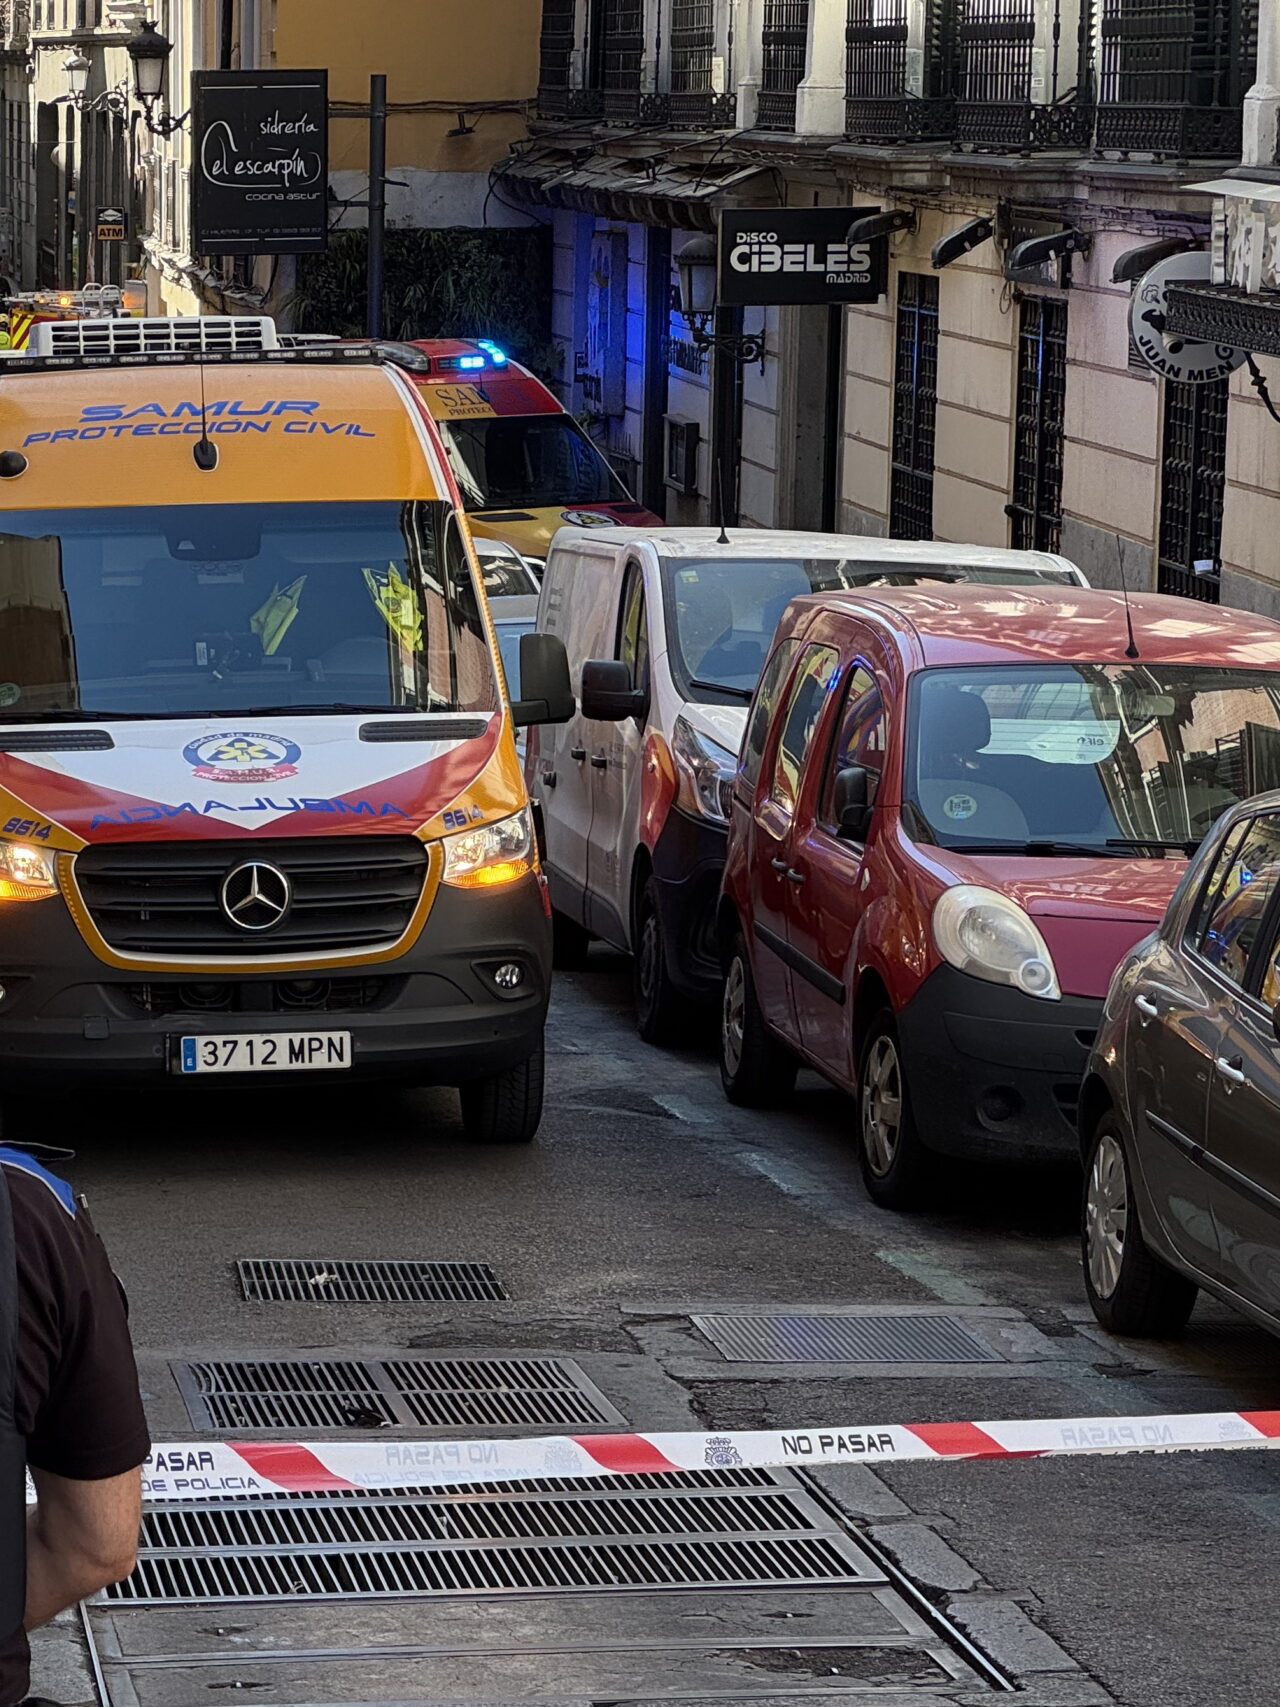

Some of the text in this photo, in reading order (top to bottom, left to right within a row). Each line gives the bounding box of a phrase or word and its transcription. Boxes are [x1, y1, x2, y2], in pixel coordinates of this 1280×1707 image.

[260, 110, 319, 134] sidrería
[234, 148, 309, 187] escarpín
[245, 193, 284, 201] cocina
[99, 228, 123, 237] ATM
[1138, 335, 1182, 379] JUAN
[79, 400, 320, 423] SAMUR
[22, 418, 376, 448] PROTECCIÓN CIVIL
[2, 816, 52, 841] 8614
[442, 804, 484, 830] 8614
[186, 1057, 193, 1066] E
[202, 1036, 345, 1067] 3712 MPN
[781, 1433, 896, 1455] NO PASAR
[174, 1477, 261, 1491] POLICIA
